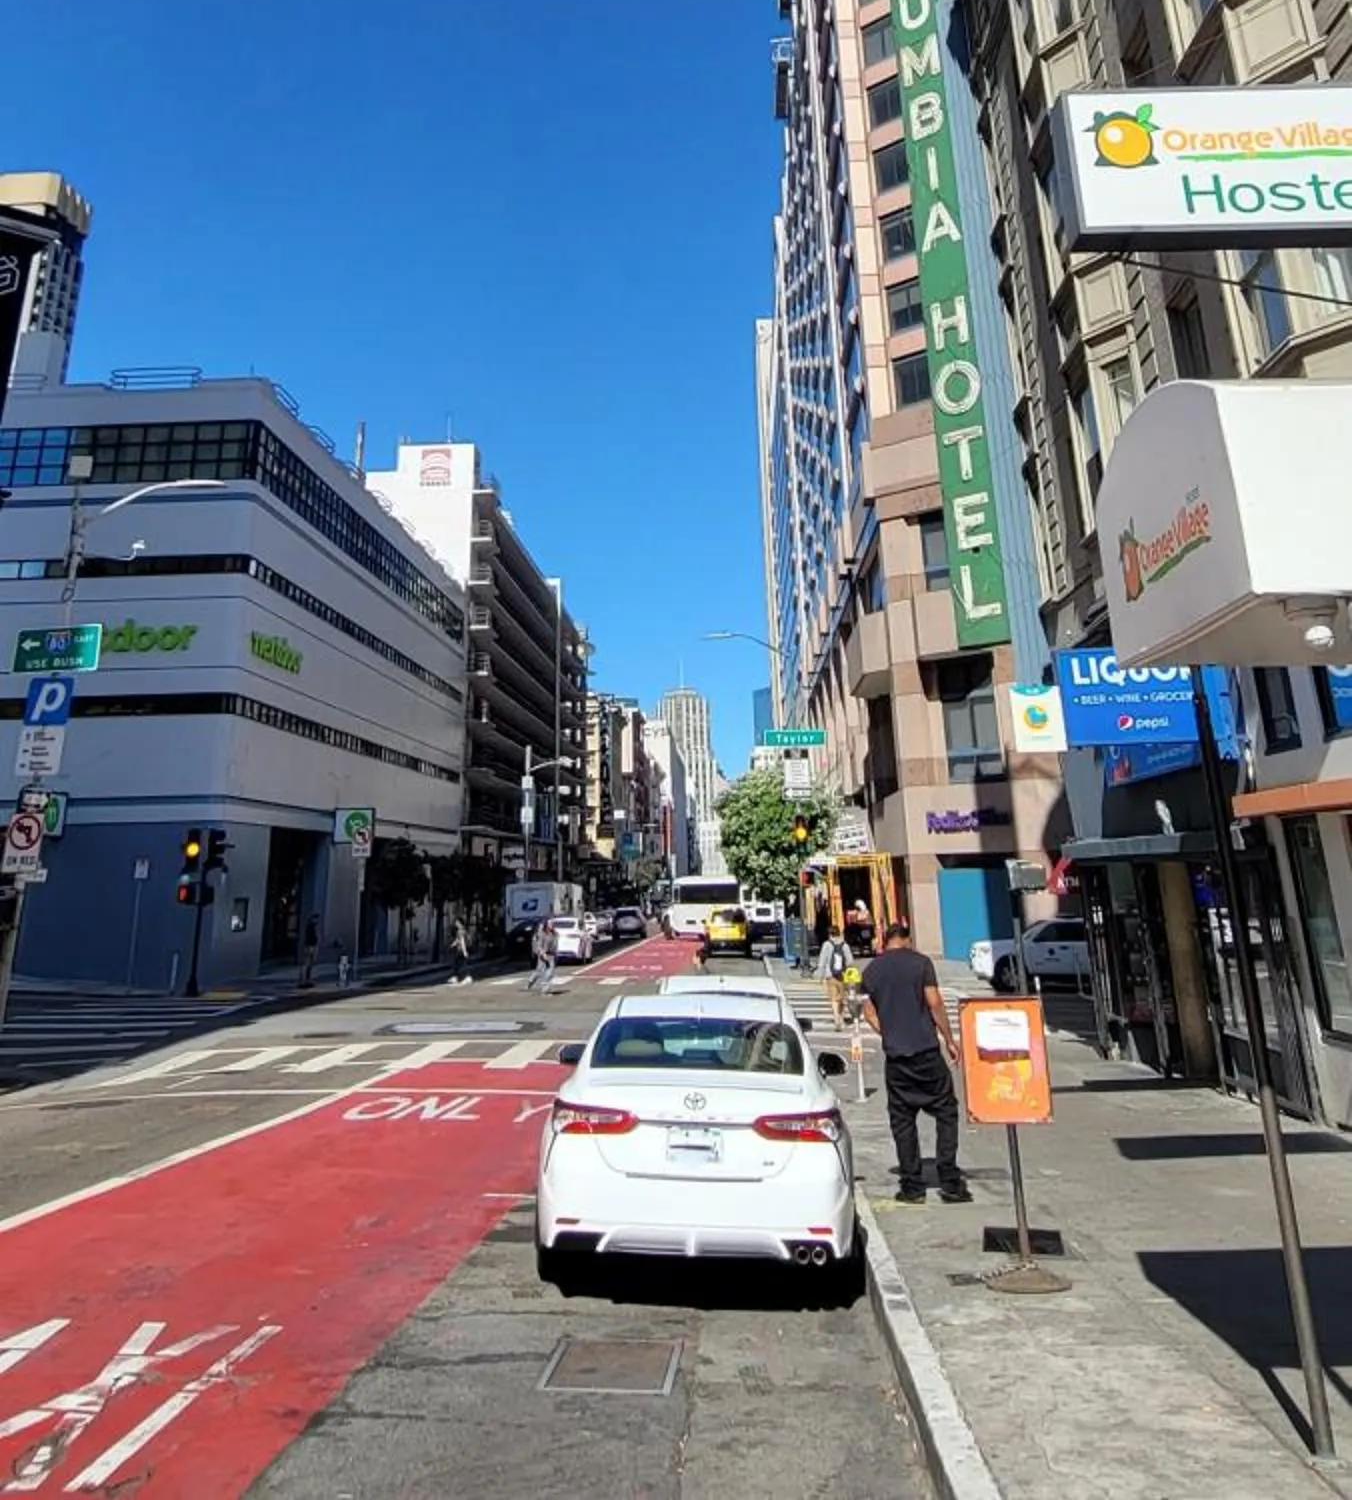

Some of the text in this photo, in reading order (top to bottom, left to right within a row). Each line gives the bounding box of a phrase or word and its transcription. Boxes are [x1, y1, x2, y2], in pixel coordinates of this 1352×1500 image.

[1163, 127, 1273, 158] Orange
[931, 295, 1002, 621] HOTEL
[1171, 502, 1209, 547] Village
[25, 657, 84, 669] USE BUSH
[1080, 695, 1106, 705] BEER
[1114, 693, 1141, 703] WINE
[1135, 716, 1169, 729] pepsi
[776, 733, 815, 745] Taylor
